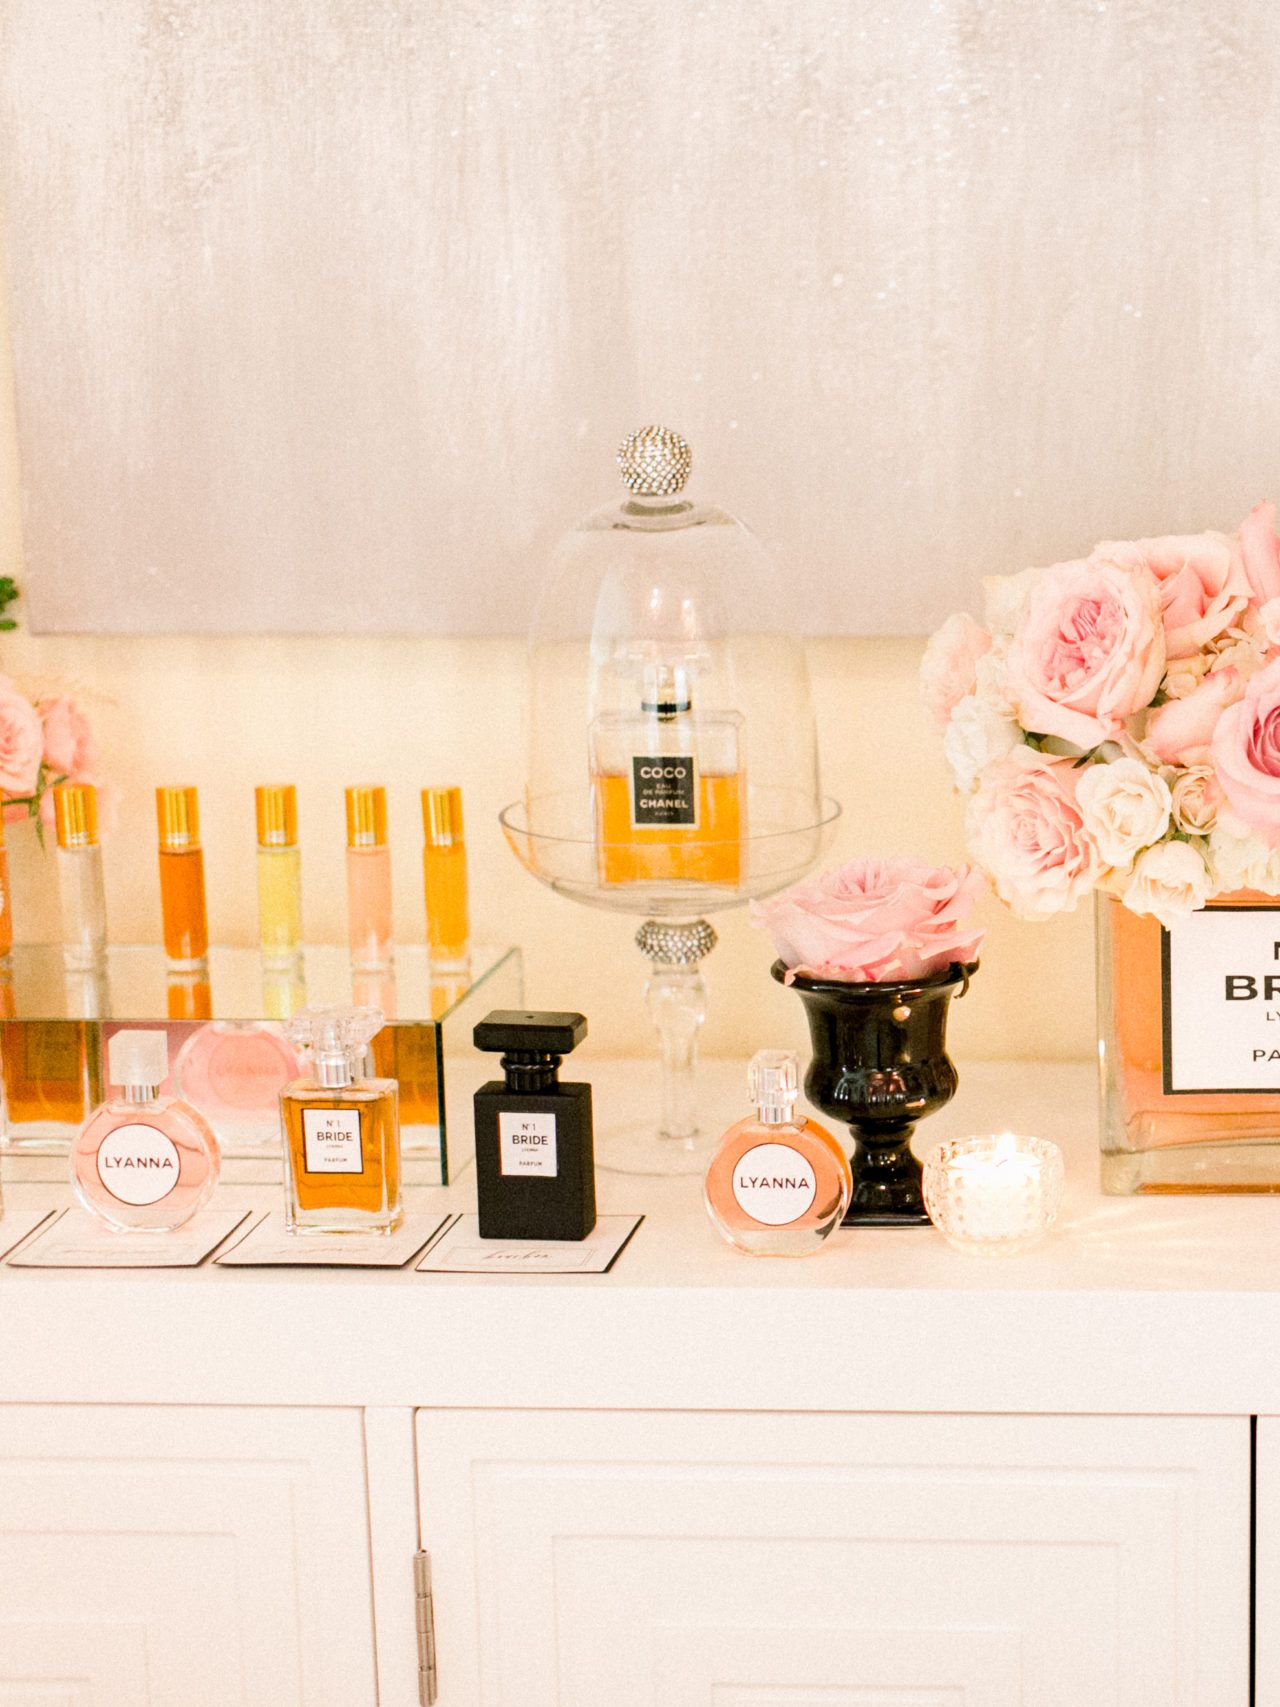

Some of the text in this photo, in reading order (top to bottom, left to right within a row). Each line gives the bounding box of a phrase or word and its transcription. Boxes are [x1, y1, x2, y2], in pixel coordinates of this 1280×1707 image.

[640, 766, 687, 779] COCO
[639, 799, 689, 809] CHANEL
[317, 1131, 353, 1142] BRIDE
[512, 1135, 549, 1146] BRIDE
[105, 1157, 173, 1168] LYANNA
[740, 1177, 810, 1189] LYANNA
